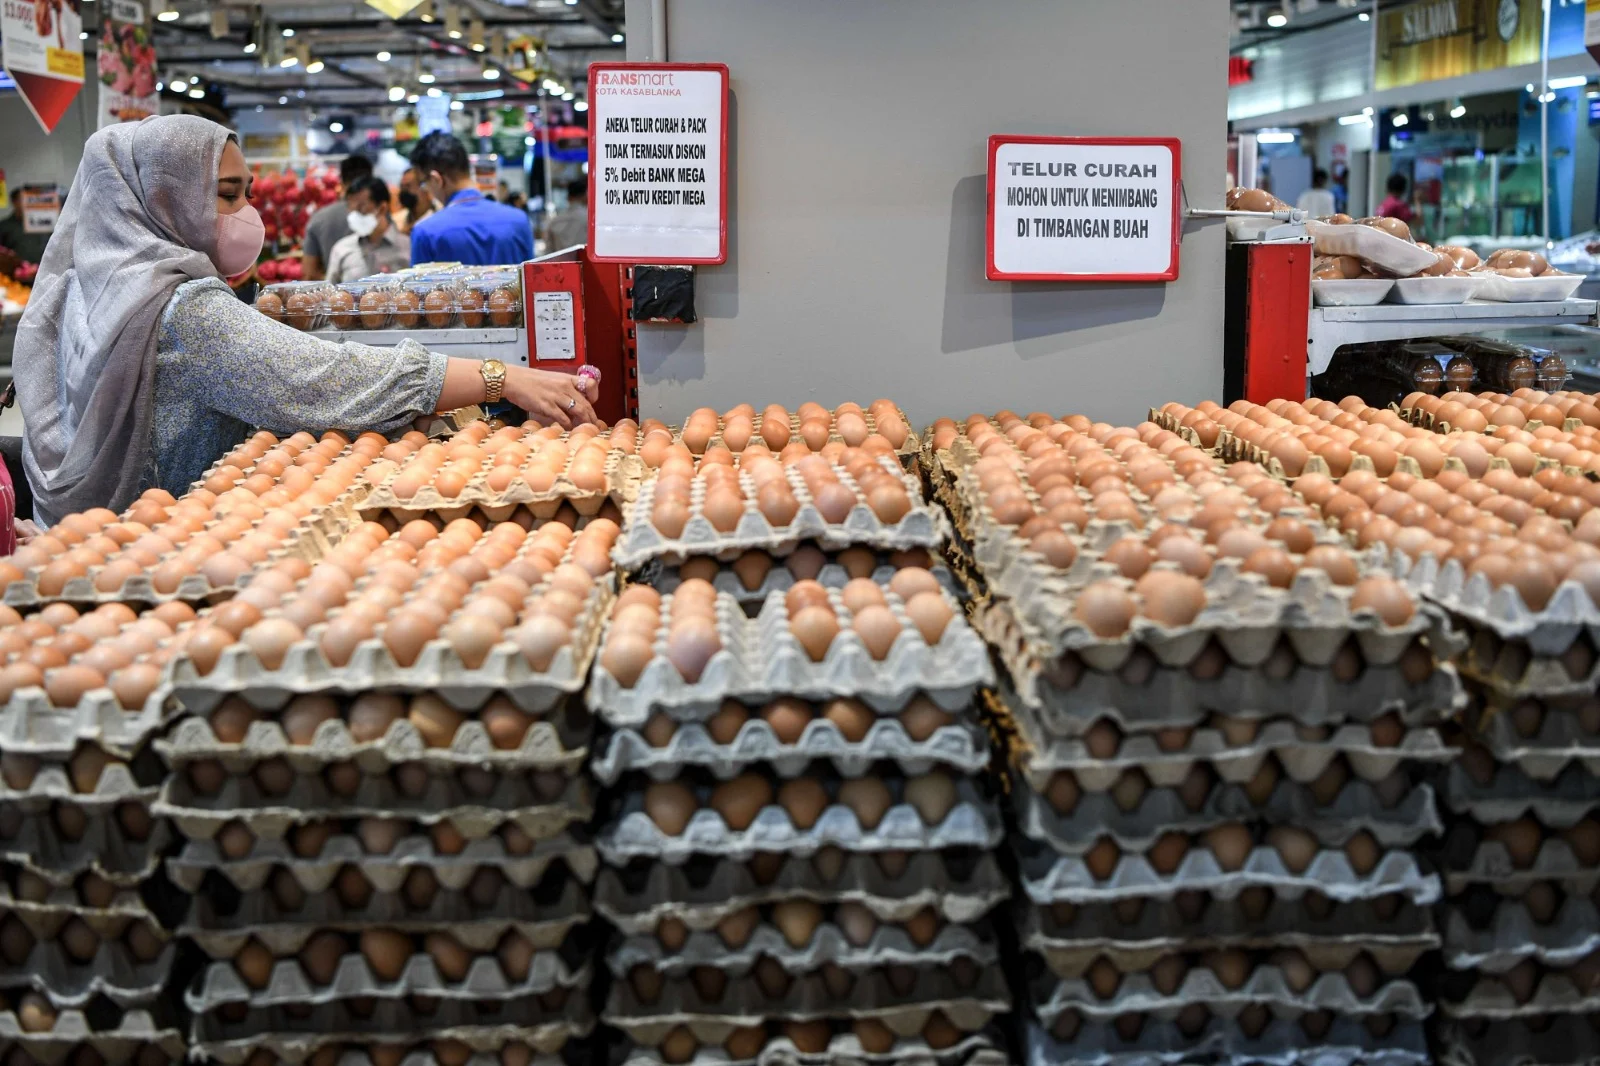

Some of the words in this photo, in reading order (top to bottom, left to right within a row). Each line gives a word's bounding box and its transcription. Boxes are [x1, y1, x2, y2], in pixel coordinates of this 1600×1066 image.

[620, 88, 681, 96] KASABLANKA
[605, 117, 629, 133] ANEKA
[630, 117, 653, 133] TELUR
[654, 117, 679, 134] CURAH
[680, 117, 686, 133] &
[687, 117, 707, 134] PACK
[604, 143, 629, 159] TIDAK
[630, 143, 674, 160] TERMASUK
[675, 144, 706, 160] DISKON
[604, 167, 619, 183] 5%
[621, 167, 646, 183] Debit
[648, 167, 675, 183] BANK
[677, 167, 706, 183] MEGA
[1007, 162, 1077, 177] TELUR
[1084, 163, 1157, 178] CURAH
[604, 189, 621, 205] 10%
[622, 189, 650, 205] KARTU
[651, 189, 681, 205] KREDIT
[682, 190, 706, 206] MEGA
[1007, 186, 1048, 207] MOHON
[1050, 187, 1089, 207] UNTUK
[1091, 188, 1158, 208] MENIMBANG
[1017, 218, 1030, 238] DI
[1033, 218, 1110, 239] TIMBANGAN
[1113, 219, 1149, 239] BUAH
